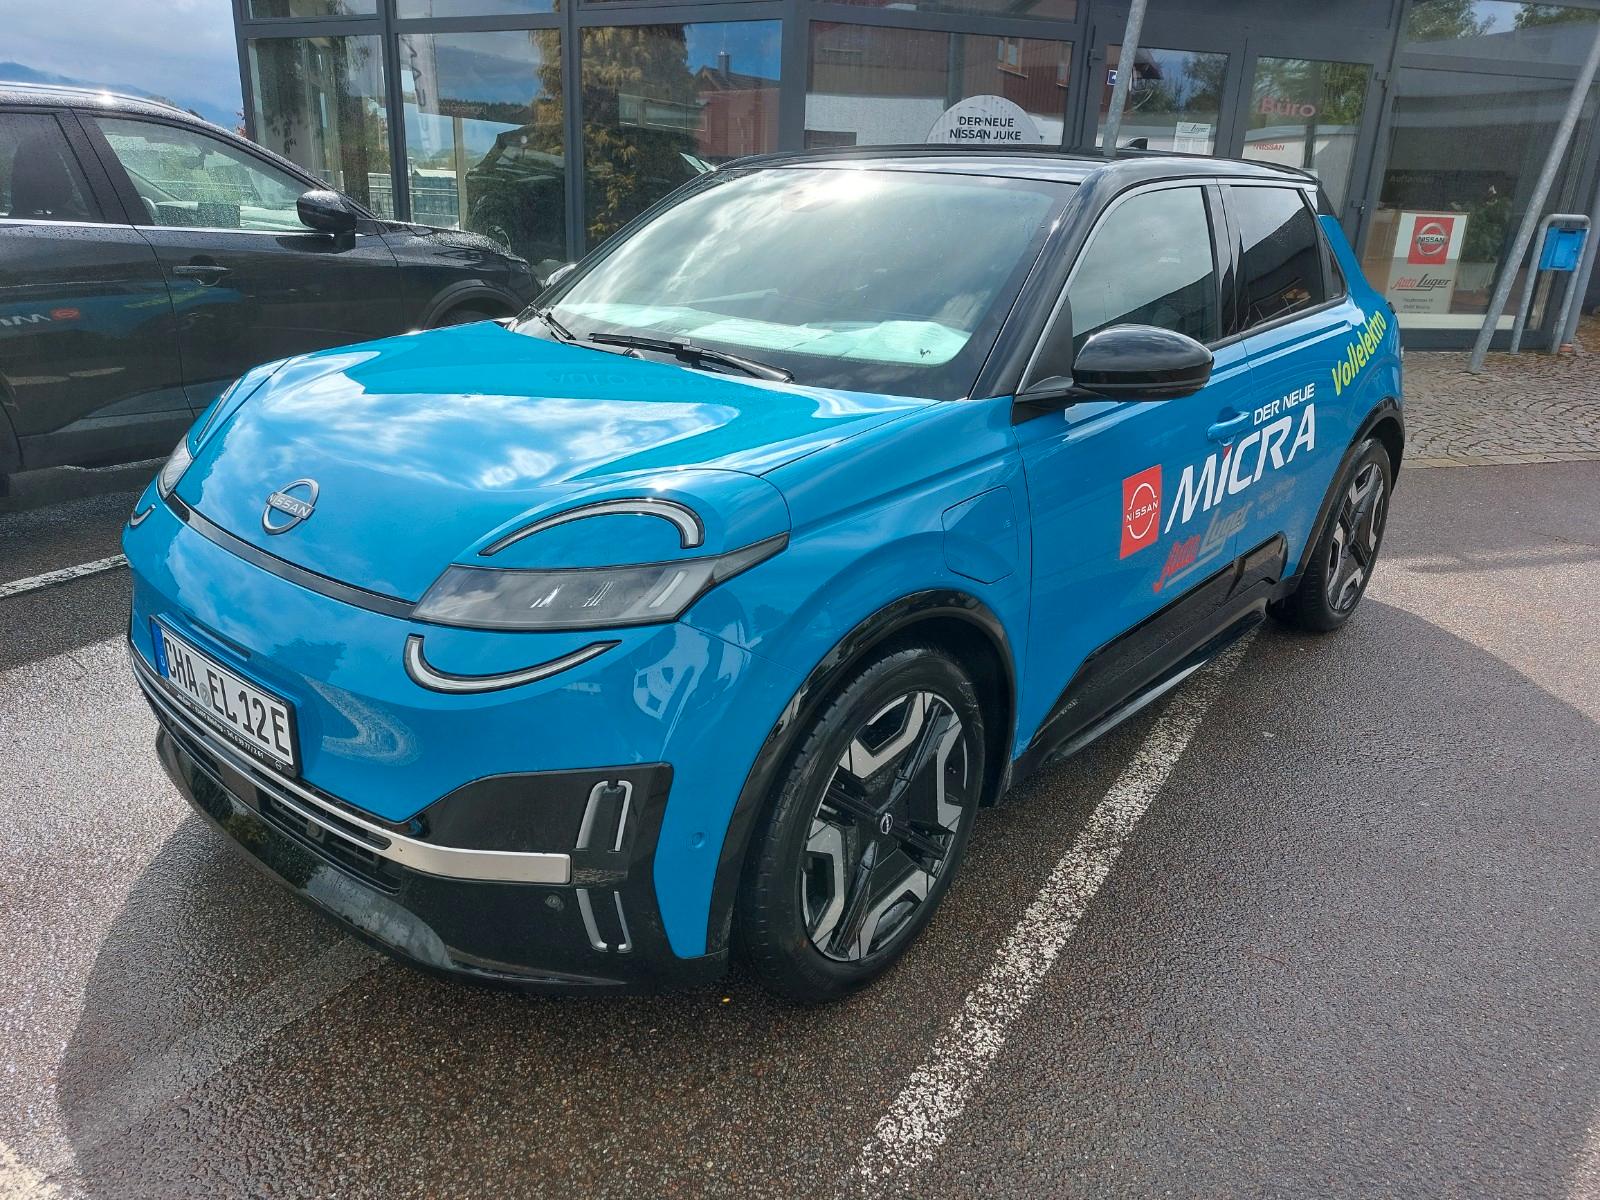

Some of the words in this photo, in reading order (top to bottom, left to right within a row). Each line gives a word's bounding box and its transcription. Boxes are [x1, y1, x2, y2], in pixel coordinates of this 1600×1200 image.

[1259, 96, 1316, 117] Büro
[959, 116, 981, 126] DER
[984, 117, 1014, 127] NEUE
[949, 129, 991, 139] NISSAN
[993, 131, 1022, 140] JUKE
[1254, 143, 1285, 151] NISSAN
[1417, 235, 1445, 244] NISSAN
[1416, 273, 1452, 292] Luger
[1253, 399, 1280, 426] DER
[1282, 382, 1315, 411] NEUE
[267, 493, 311, 517] NISSAN
[1126, 499, 1159, 522] NISSAN
[163, 637, 200, 697] CHA
[206, 668, 238, 724] EL
[238, 690, 290, 757] 12E
